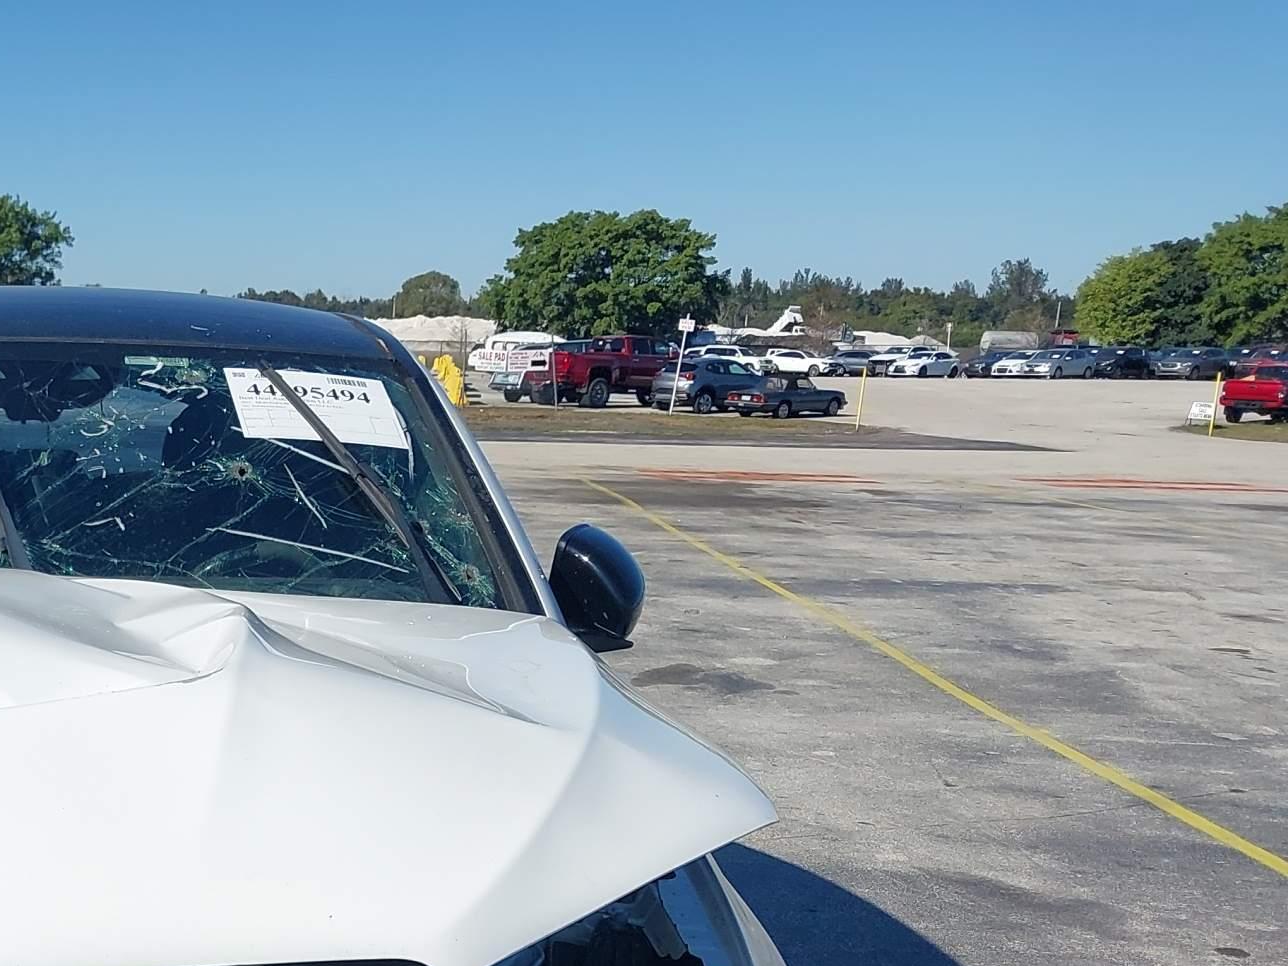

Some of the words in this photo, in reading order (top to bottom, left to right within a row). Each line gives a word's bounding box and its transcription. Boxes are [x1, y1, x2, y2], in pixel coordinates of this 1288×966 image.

[478, 351, 493, 361] SALE
[495, 352, 506, 362] PAD
[246, 383, 371, 404] 4495494
